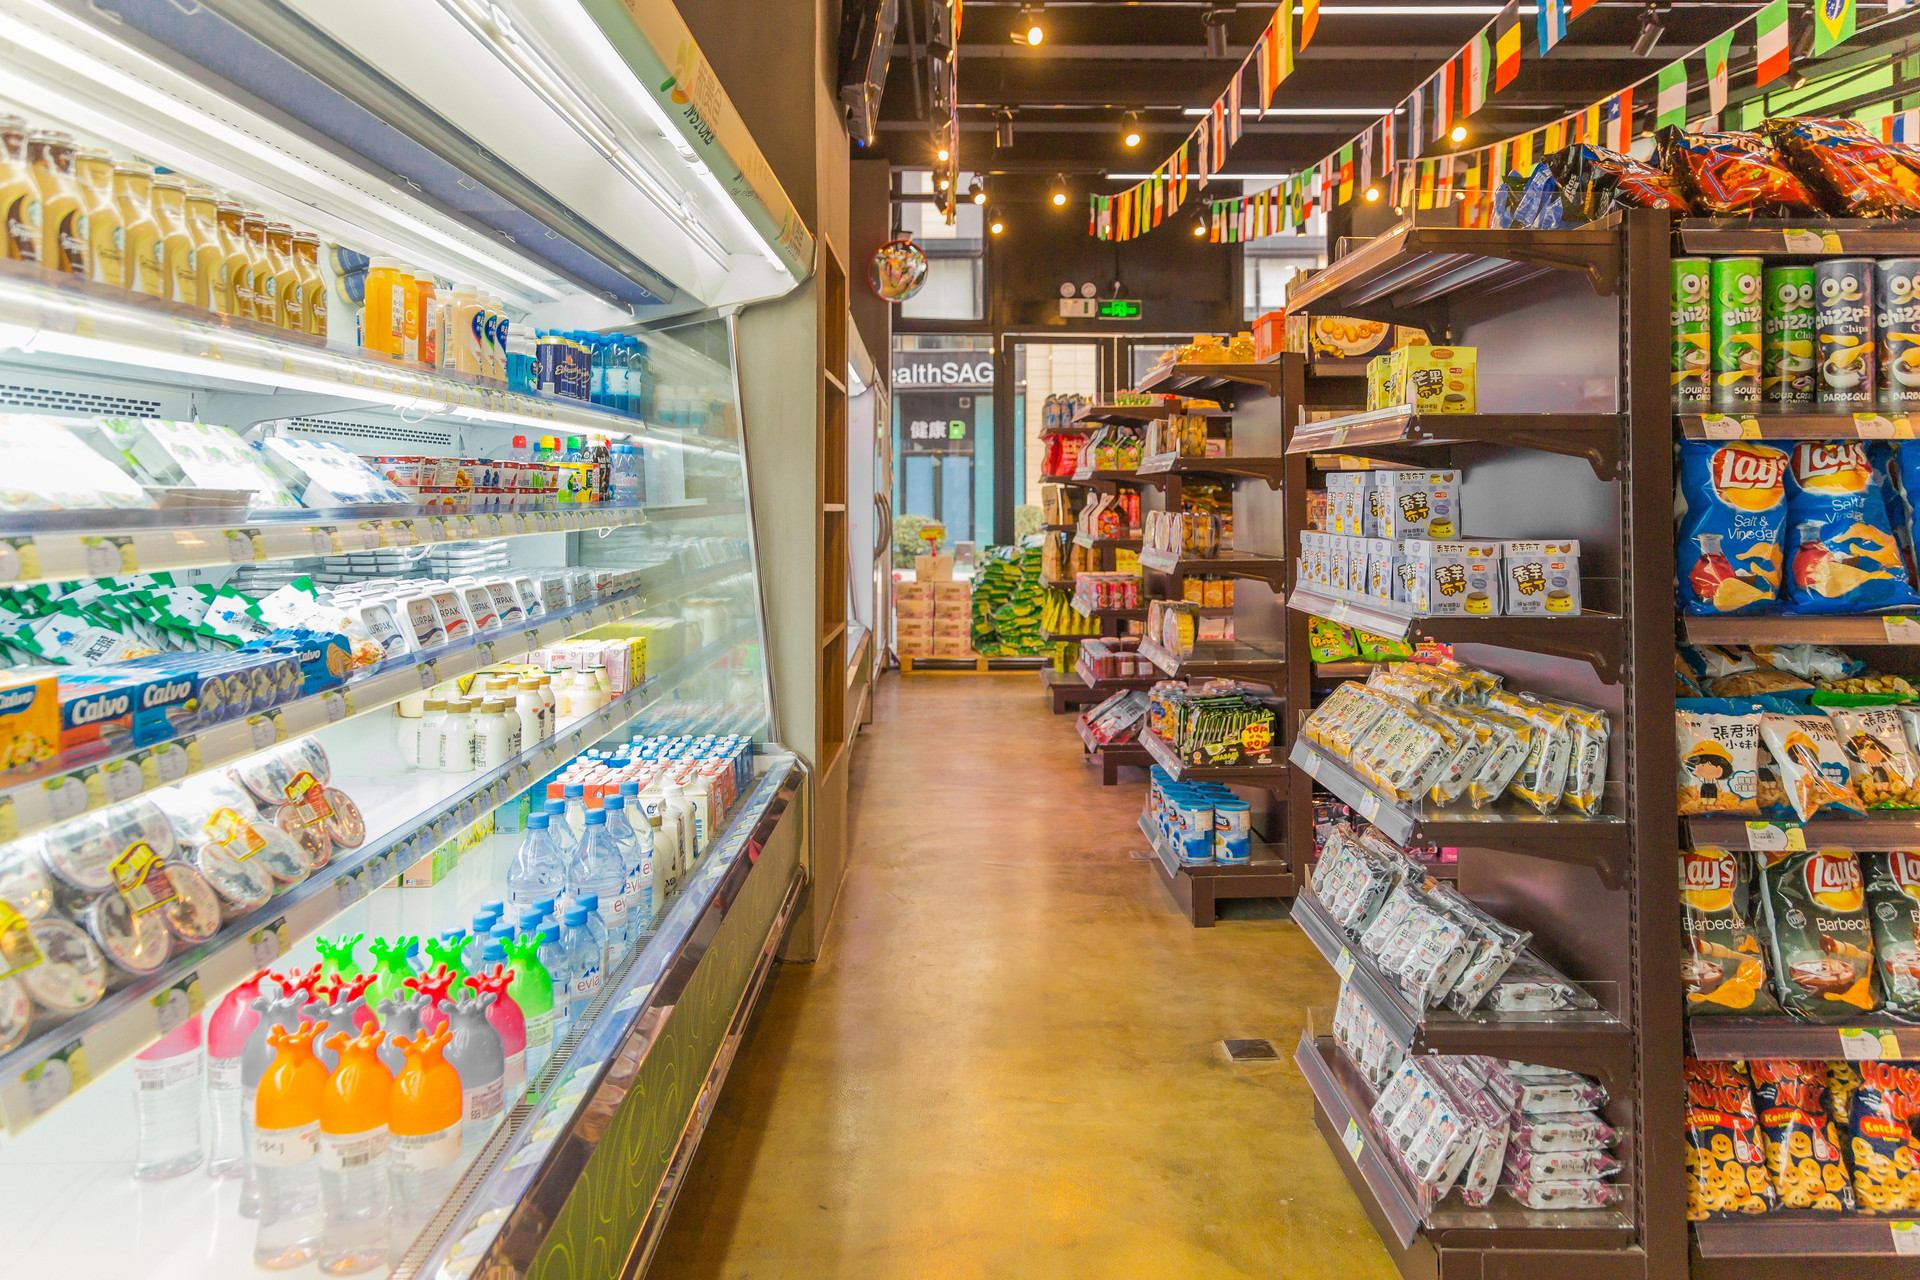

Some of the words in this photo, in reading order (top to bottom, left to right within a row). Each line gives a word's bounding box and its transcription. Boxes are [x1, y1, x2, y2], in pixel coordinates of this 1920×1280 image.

[1840, 324, 1869, 334] Chips
[1680, 386, 1703, 395] SOUR
[1734, 386, 1756, 395] SOUR
[1823, 391, 1871, 402] BARBEQUE
[910, 420, 947, 440] 健康
[1720, 450, 1788, 489] Lay's
[1734, 515, 1757, 527] Salt
[1728, 527, 1778, 543] Vinegar
[368, 621, 393, 635] LURPAK
[143, 680, 192, 708] Calvo
[71, 694, 130, 724] Calvo
[1246, 726, 1267, 734] TOP
[1246, 740, 1268, 749] POP
[1682, 917, 1745, 931] Barbecue
